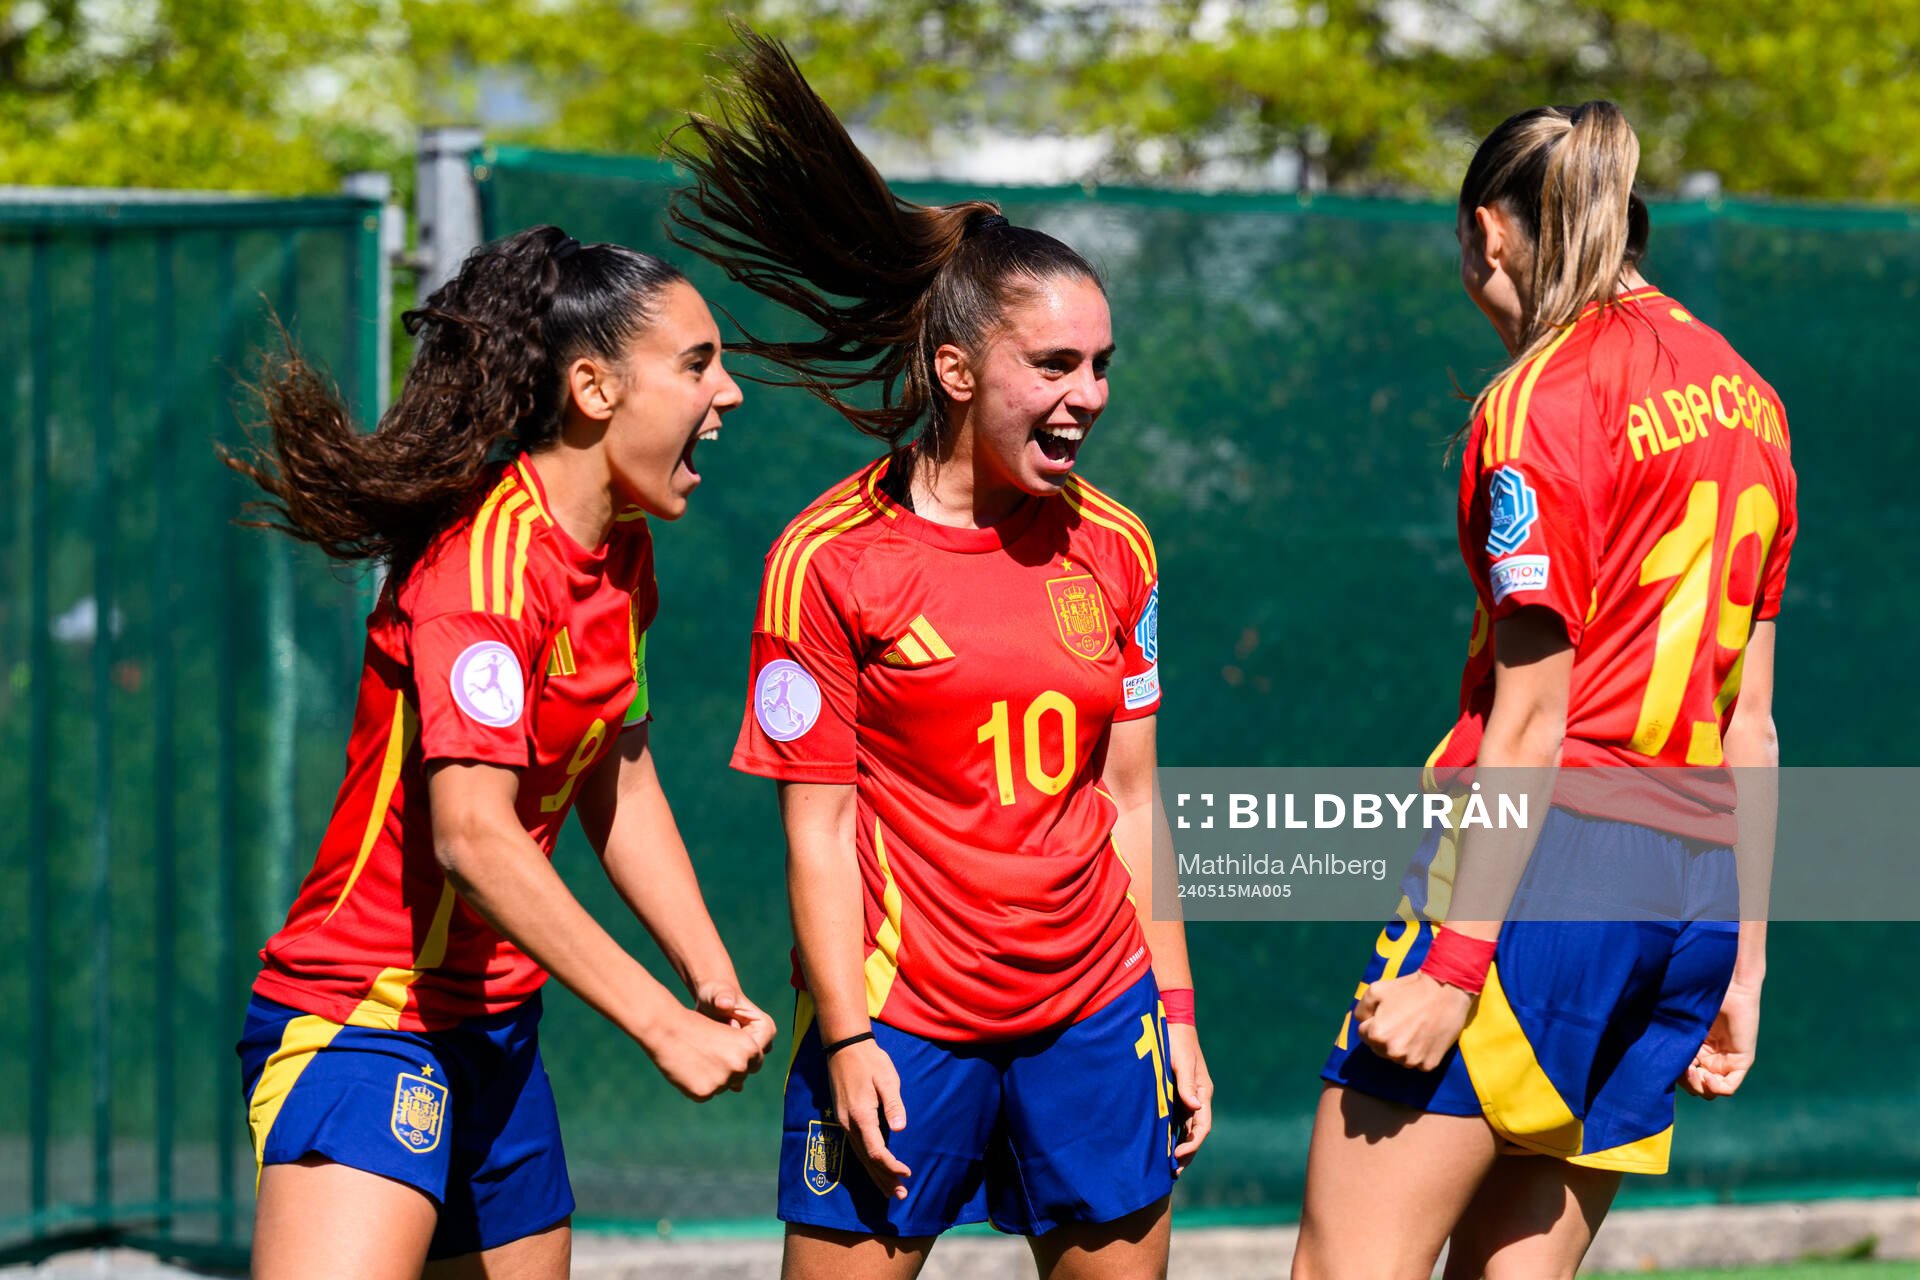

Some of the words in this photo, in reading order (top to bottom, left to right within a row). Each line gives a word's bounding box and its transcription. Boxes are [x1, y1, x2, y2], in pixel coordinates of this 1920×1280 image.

[1629, 480, 1780, 767] 19
[1126, 679, 1157, 698] FOUN
[540, 717, 607, 813] 9
[977, 689, 1077, 806] 10
